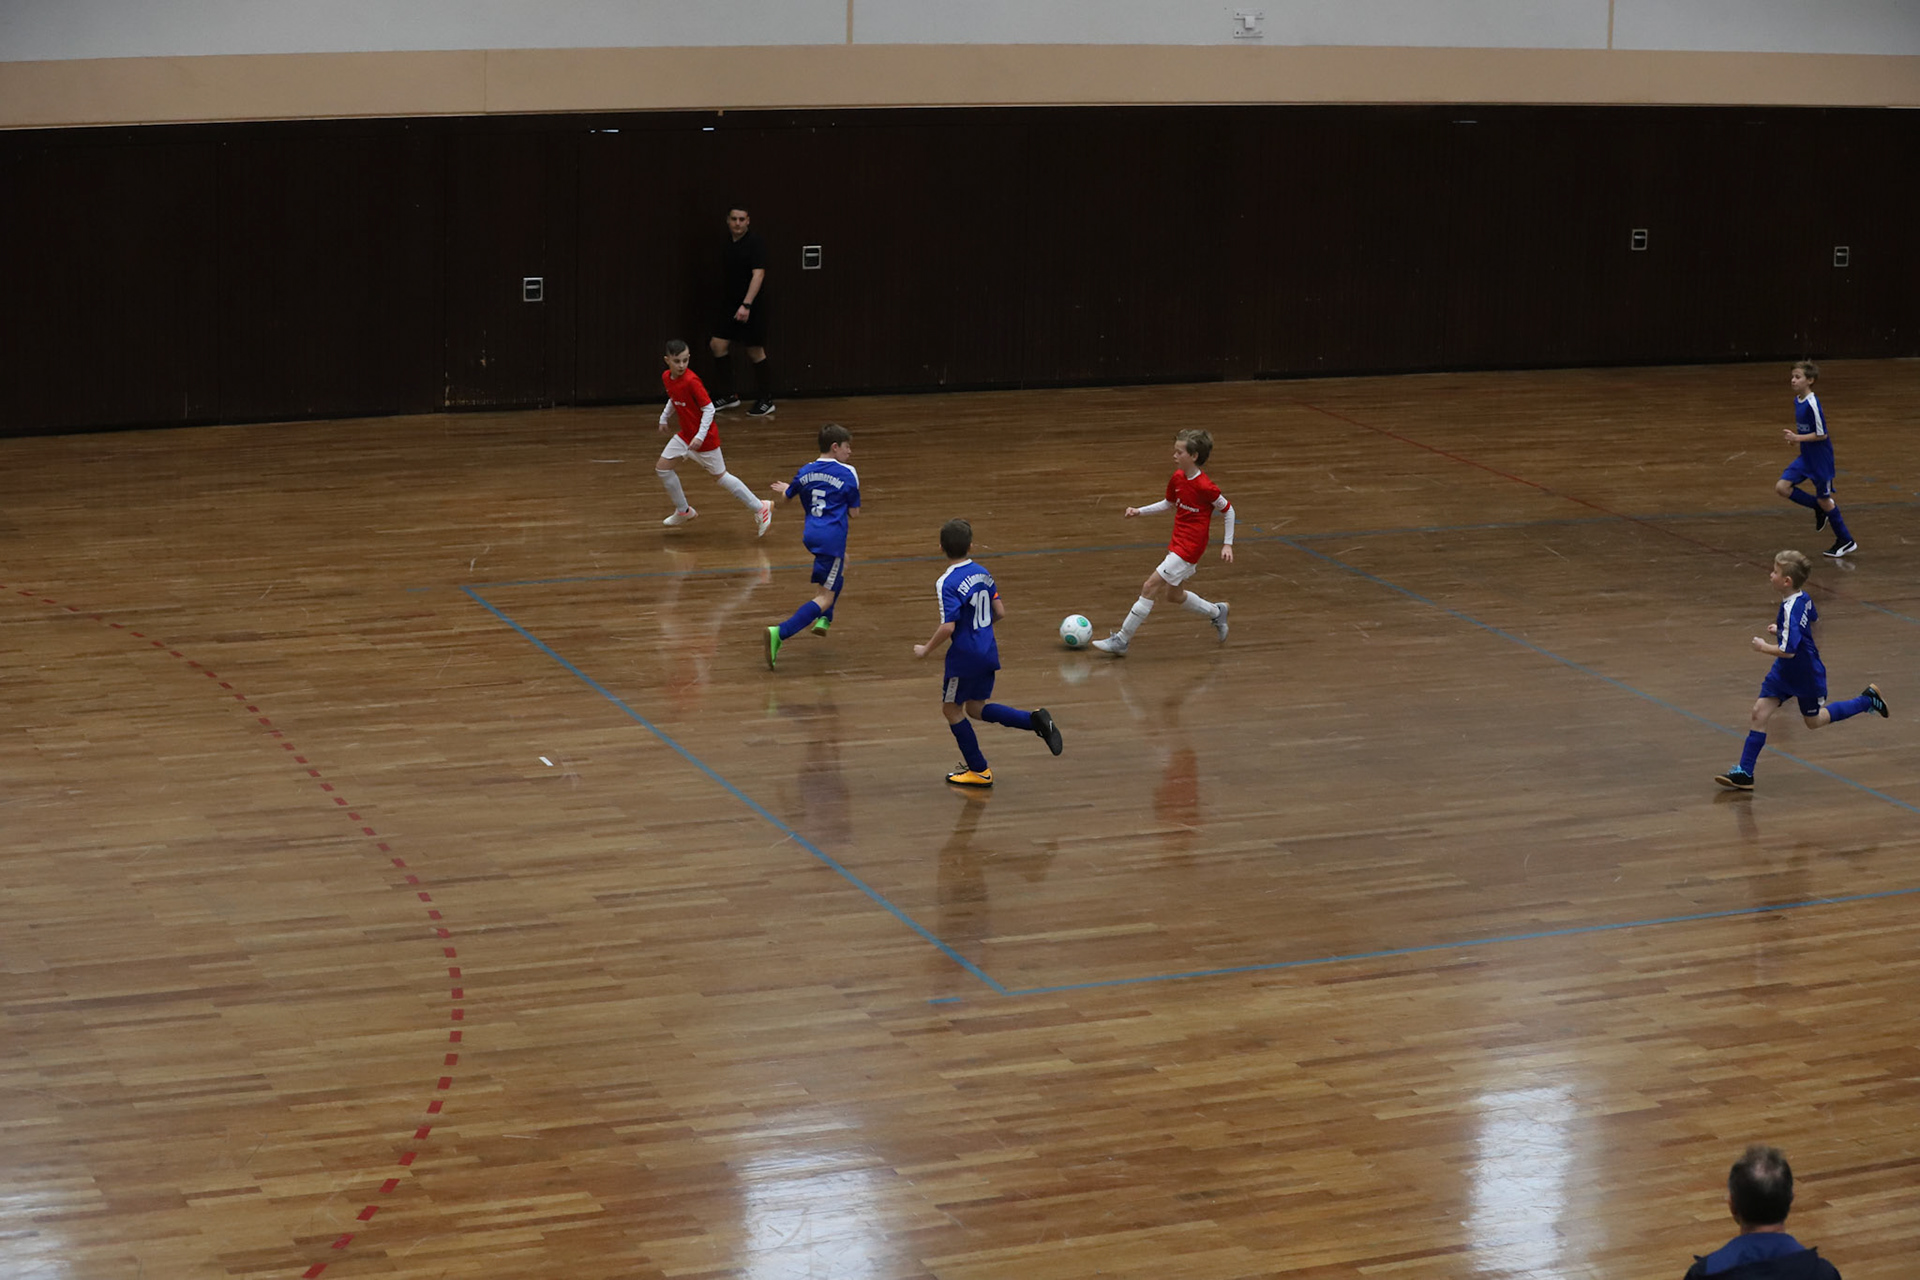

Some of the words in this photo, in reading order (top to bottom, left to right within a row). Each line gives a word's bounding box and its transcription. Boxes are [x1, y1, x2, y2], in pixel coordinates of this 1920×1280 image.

[811, 488, 826, 518] 5
[957, 580, 970, 596] TSV
[969, 589, 992, 630] 10
